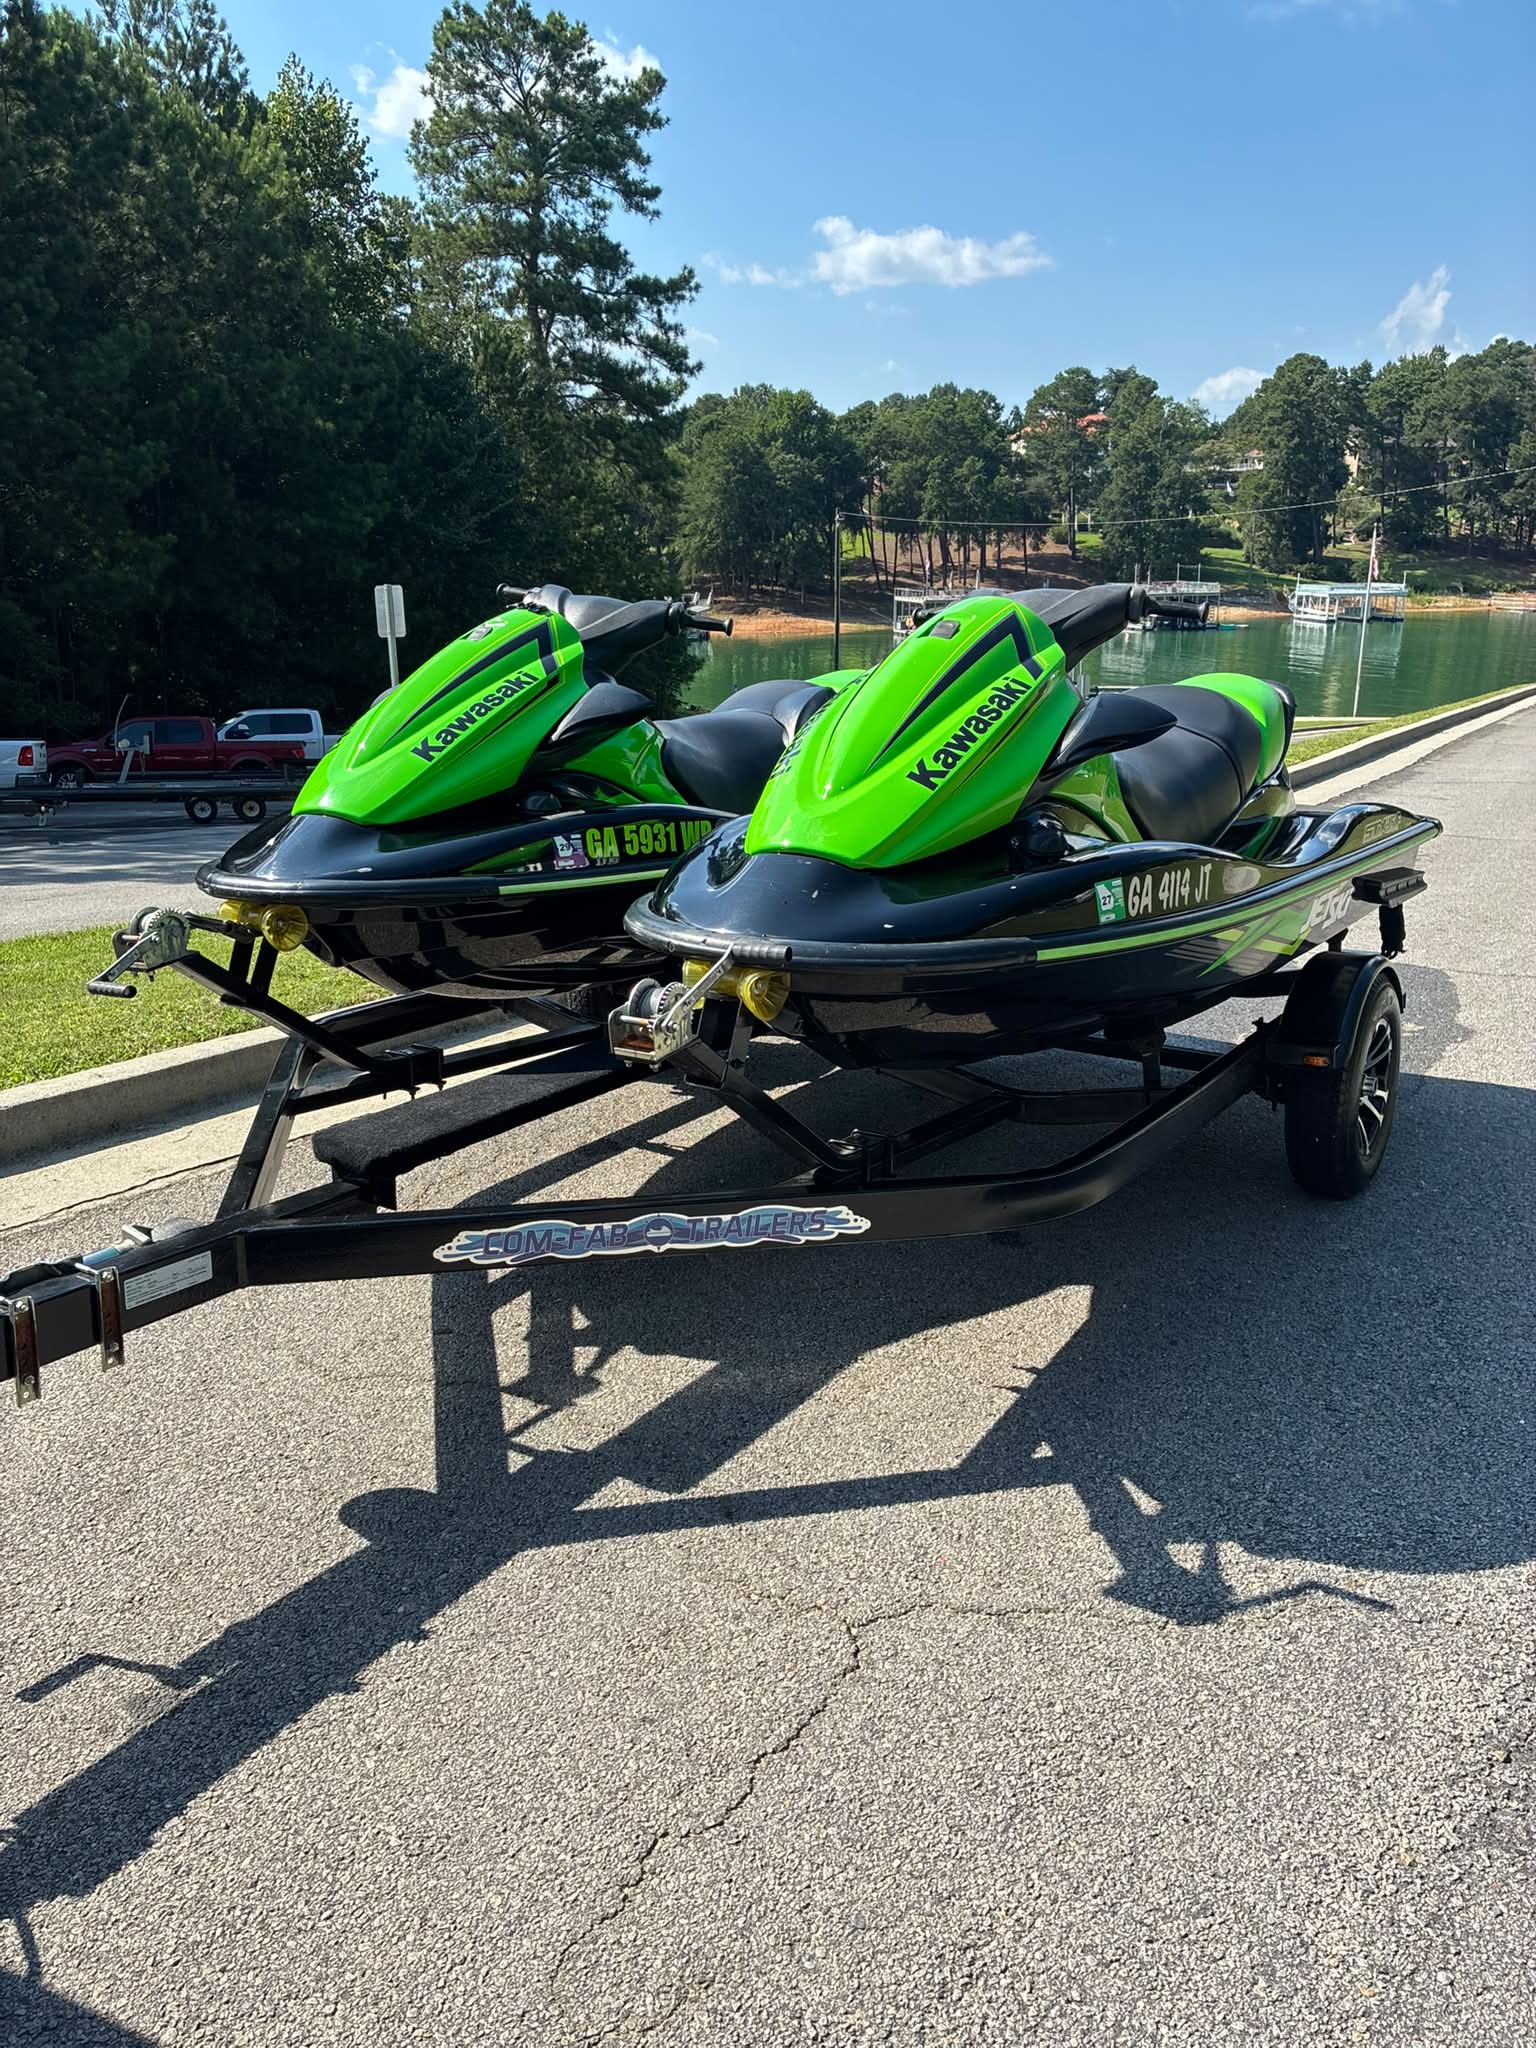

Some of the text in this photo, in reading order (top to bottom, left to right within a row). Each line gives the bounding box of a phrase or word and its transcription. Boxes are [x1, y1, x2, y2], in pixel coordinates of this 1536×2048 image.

[411, 670, 540, 762] Kawasaki
[906, 676, 1033, 791] Kawasaki
[585, 826, 620, 859] GA
[623, 822, 677, 855] 5931
[1101, 895, 1112, 906] 27
[1128, 874, 1153, 917] GA
[1158, 867, 1191, 910] 4114
[1195, 863, 1213, 903] JT
[483, 1209, 828, 1255] COM-FAB TRAILERS
